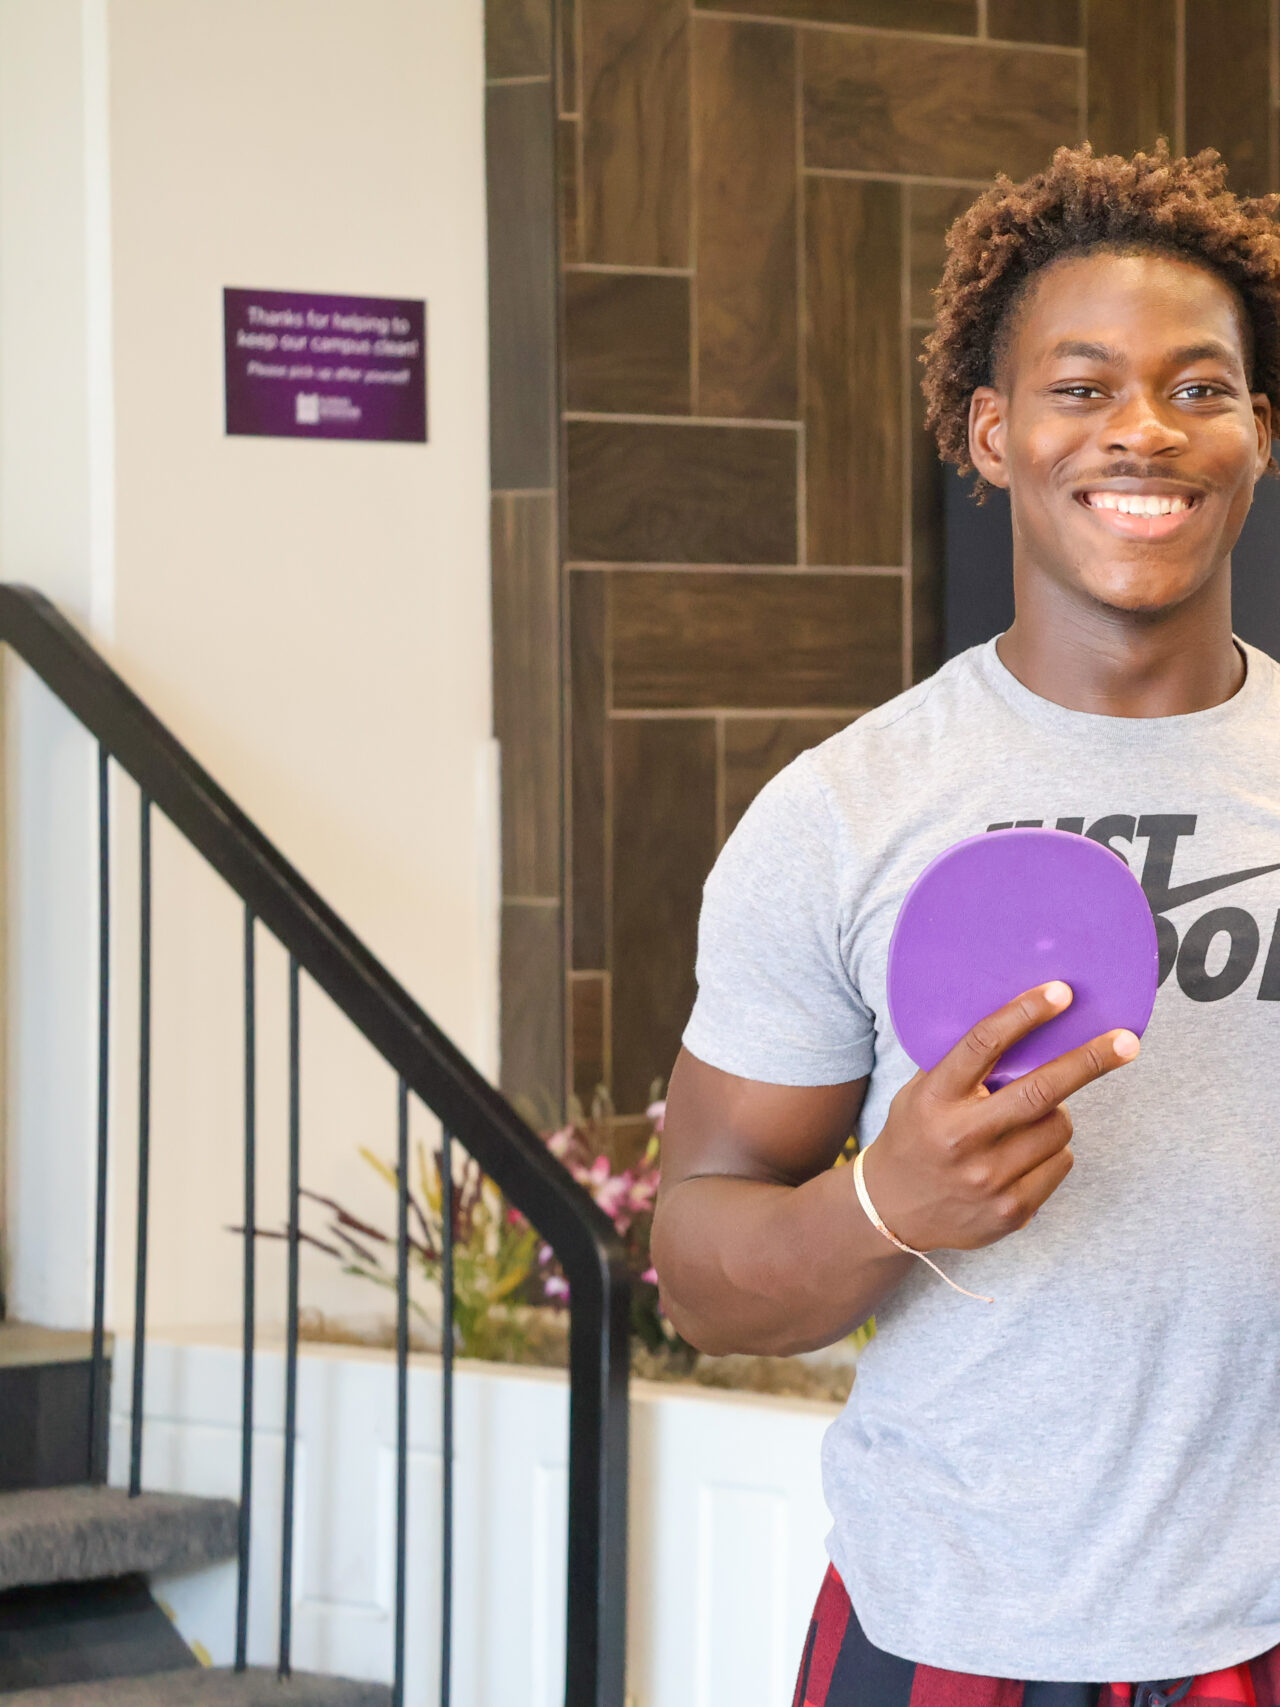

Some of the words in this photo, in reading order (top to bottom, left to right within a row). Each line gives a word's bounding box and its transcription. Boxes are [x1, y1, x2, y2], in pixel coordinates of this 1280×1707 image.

[247, 305, 304, 329] Thanks
[306, 309, 329, 329] for
[331, 311, 391, 336] helping
[391, 316, 411, 335] to
[236, 328, 279, 352] keep
[280, 334, 307, 352] our
[309, 335, 371, 355] campus
